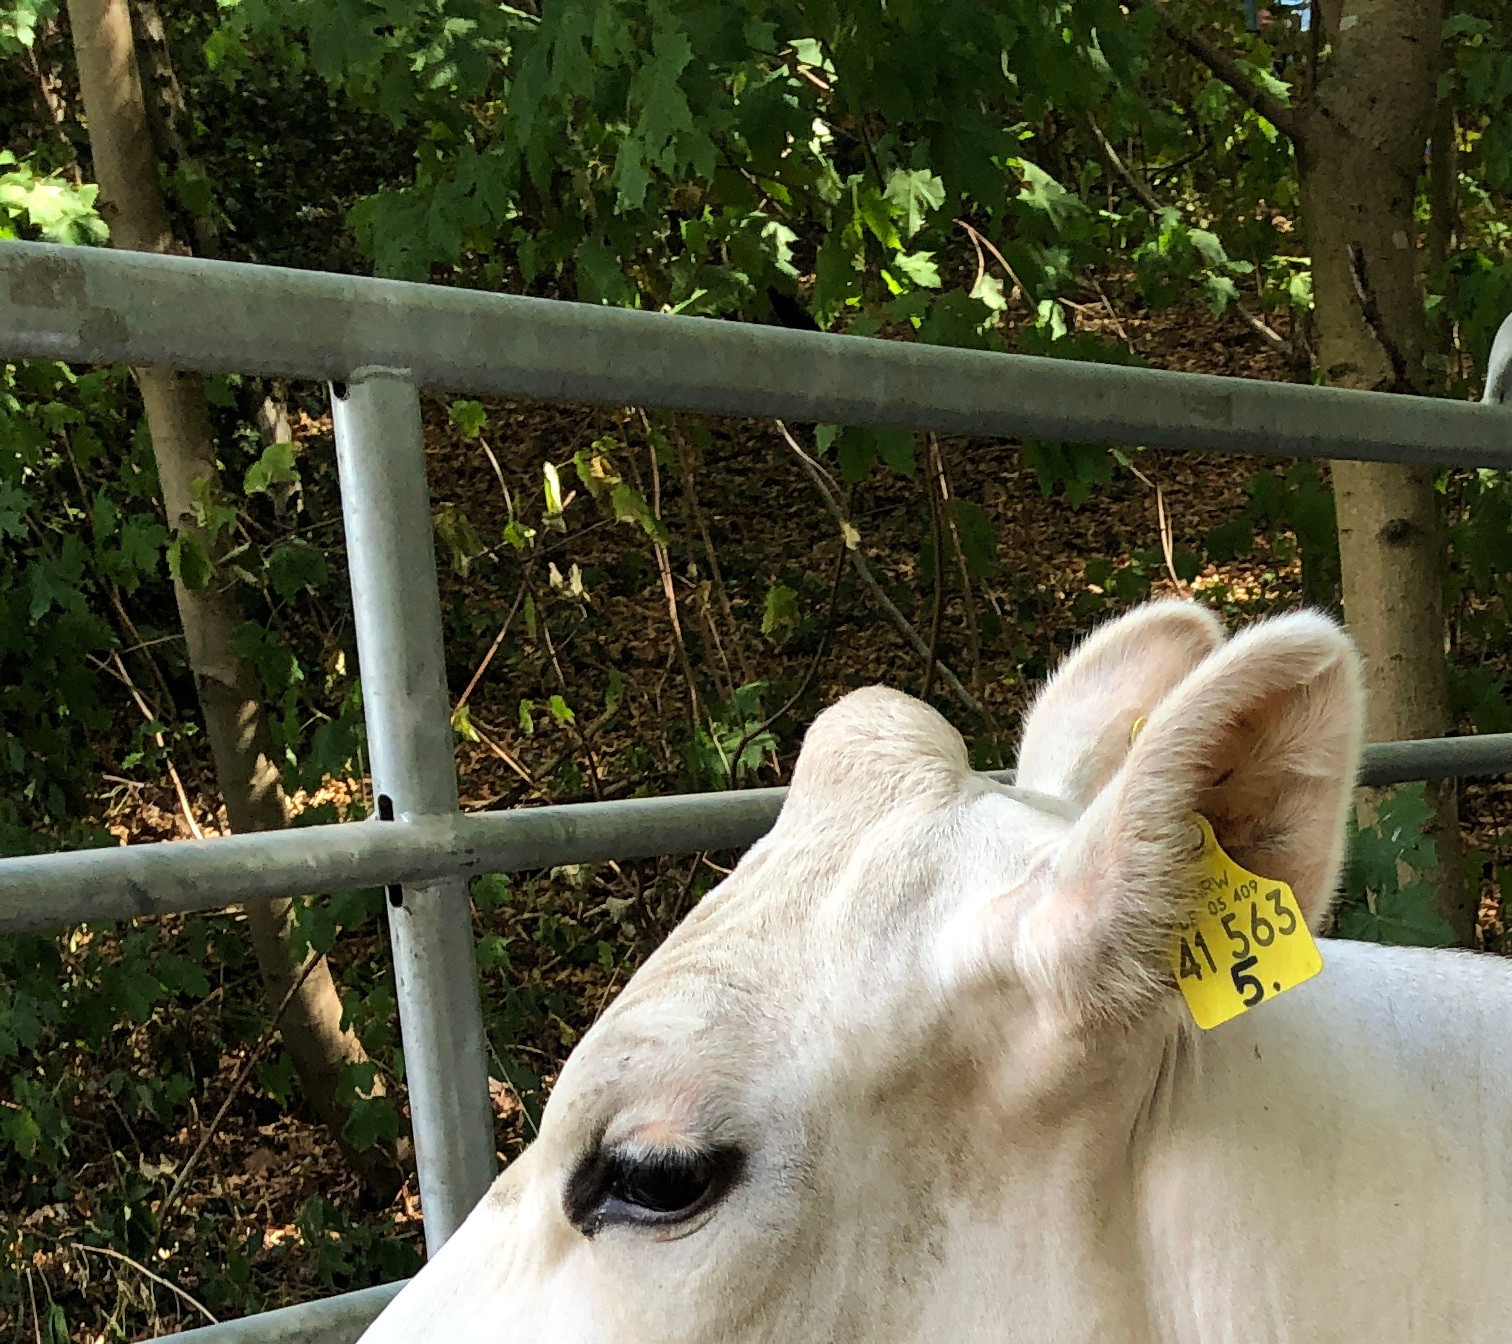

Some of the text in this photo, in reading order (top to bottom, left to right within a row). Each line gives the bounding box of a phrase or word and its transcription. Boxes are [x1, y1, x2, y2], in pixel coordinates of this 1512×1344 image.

[1208, 879, 1258, 915] 05 409
[1180, 888, 1297, 981] 41 563
